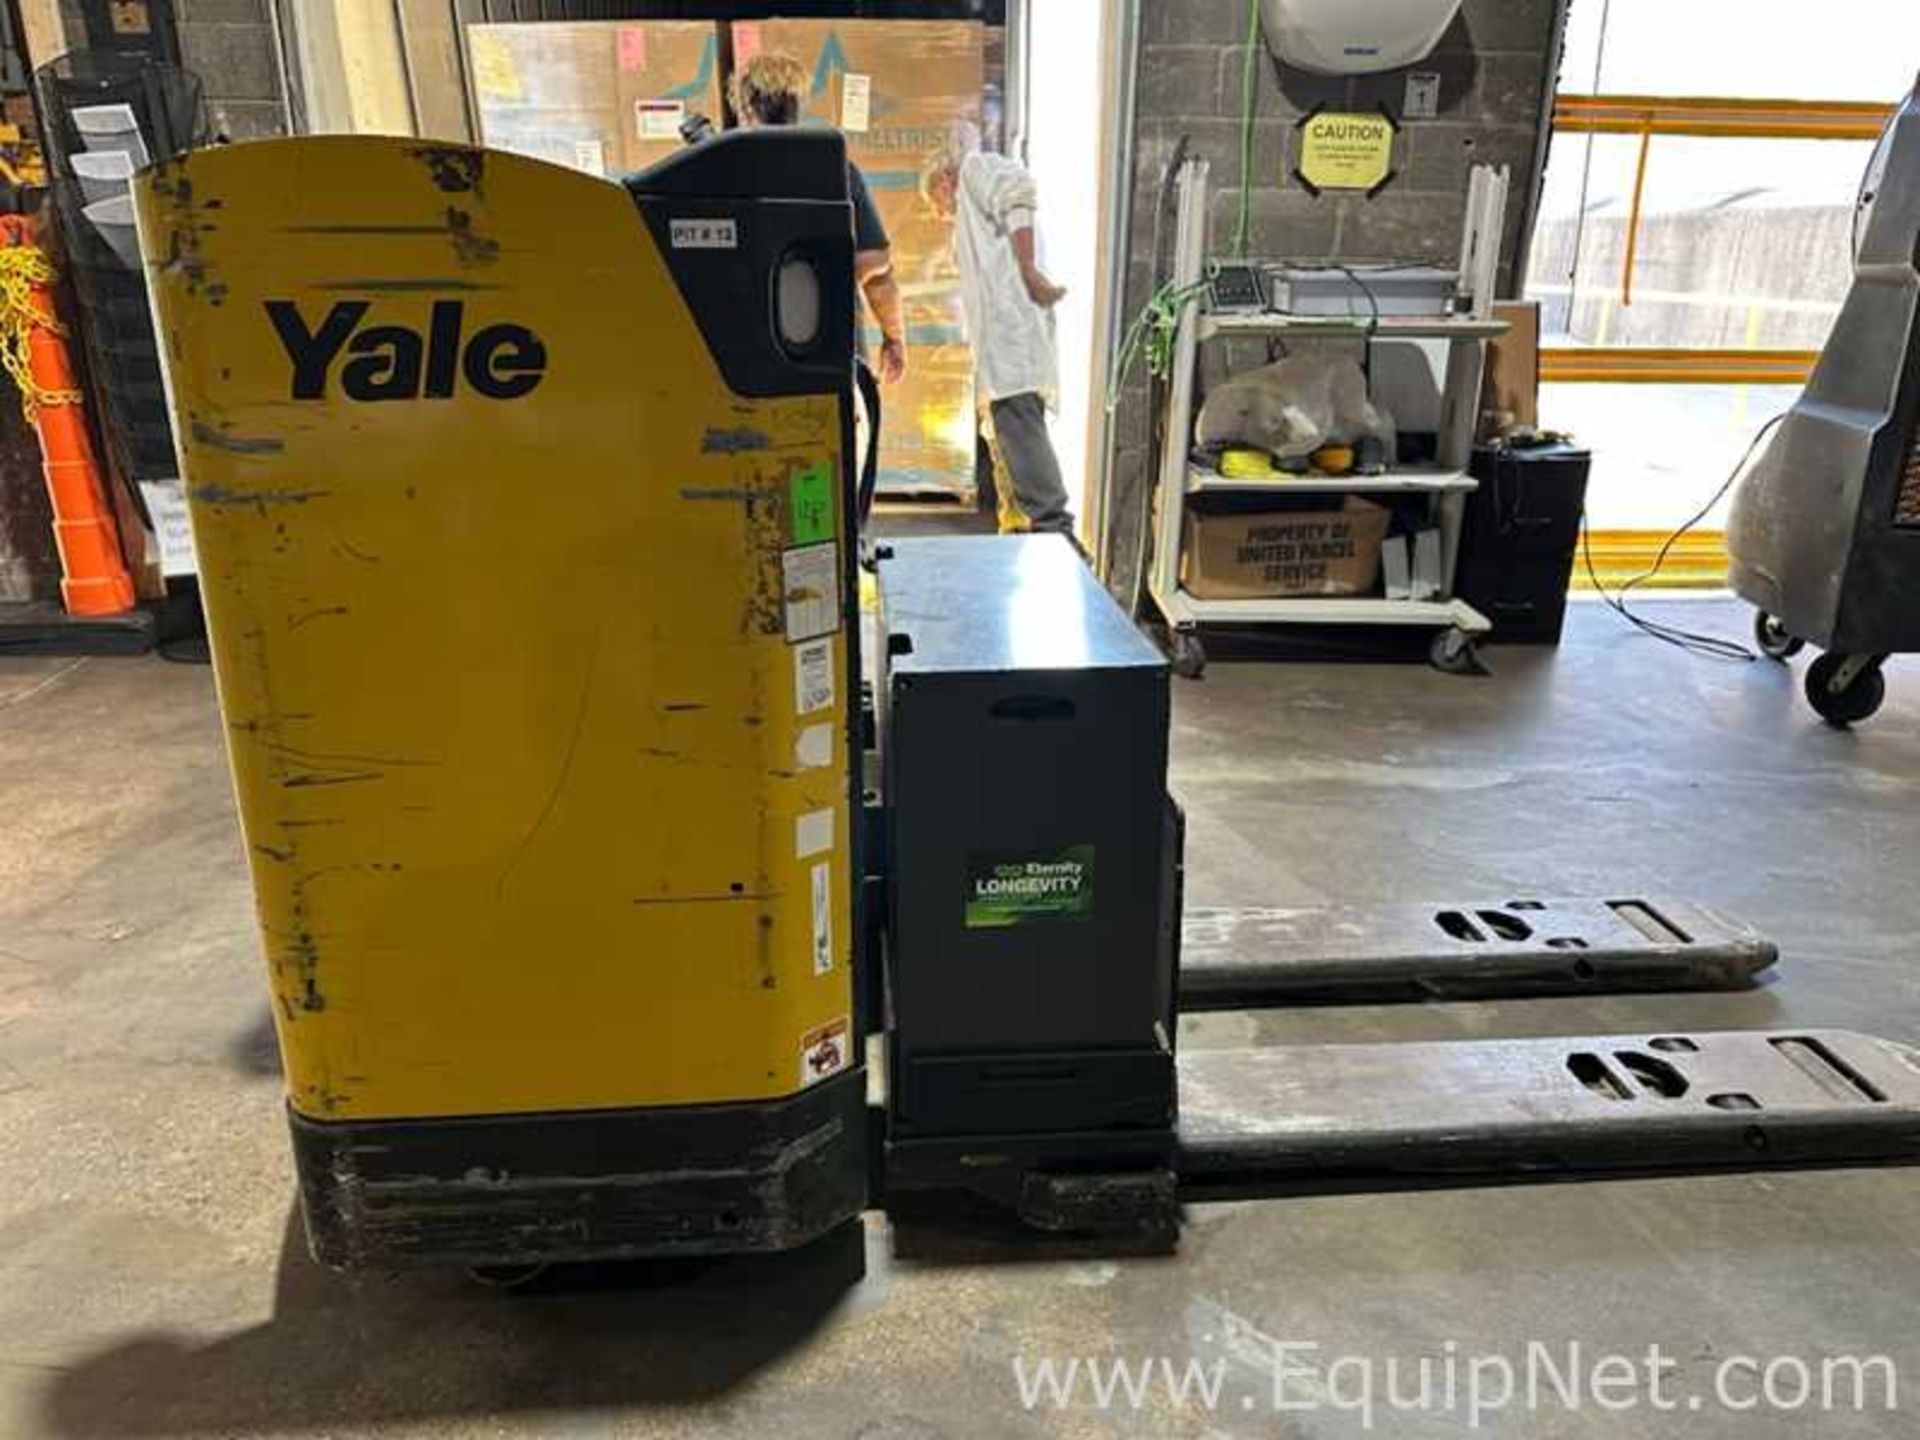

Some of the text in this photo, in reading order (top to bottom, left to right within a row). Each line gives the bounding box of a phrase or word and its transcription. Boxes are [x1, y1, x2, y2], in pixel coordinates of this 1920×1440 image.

[1312, 123, 1383, 140] CAUTION
[263, 300, 547, 401] Yale
[1247, 523, 1327, 542] PROPERTY
[1237, 542, 1356, 564] UNITED PARCEL
[1264, 563, 1327, 582] SERVICE
[1026, 862, 1083, 876] Eternity
[976, 877, 1083, 895] LONGEVITY
